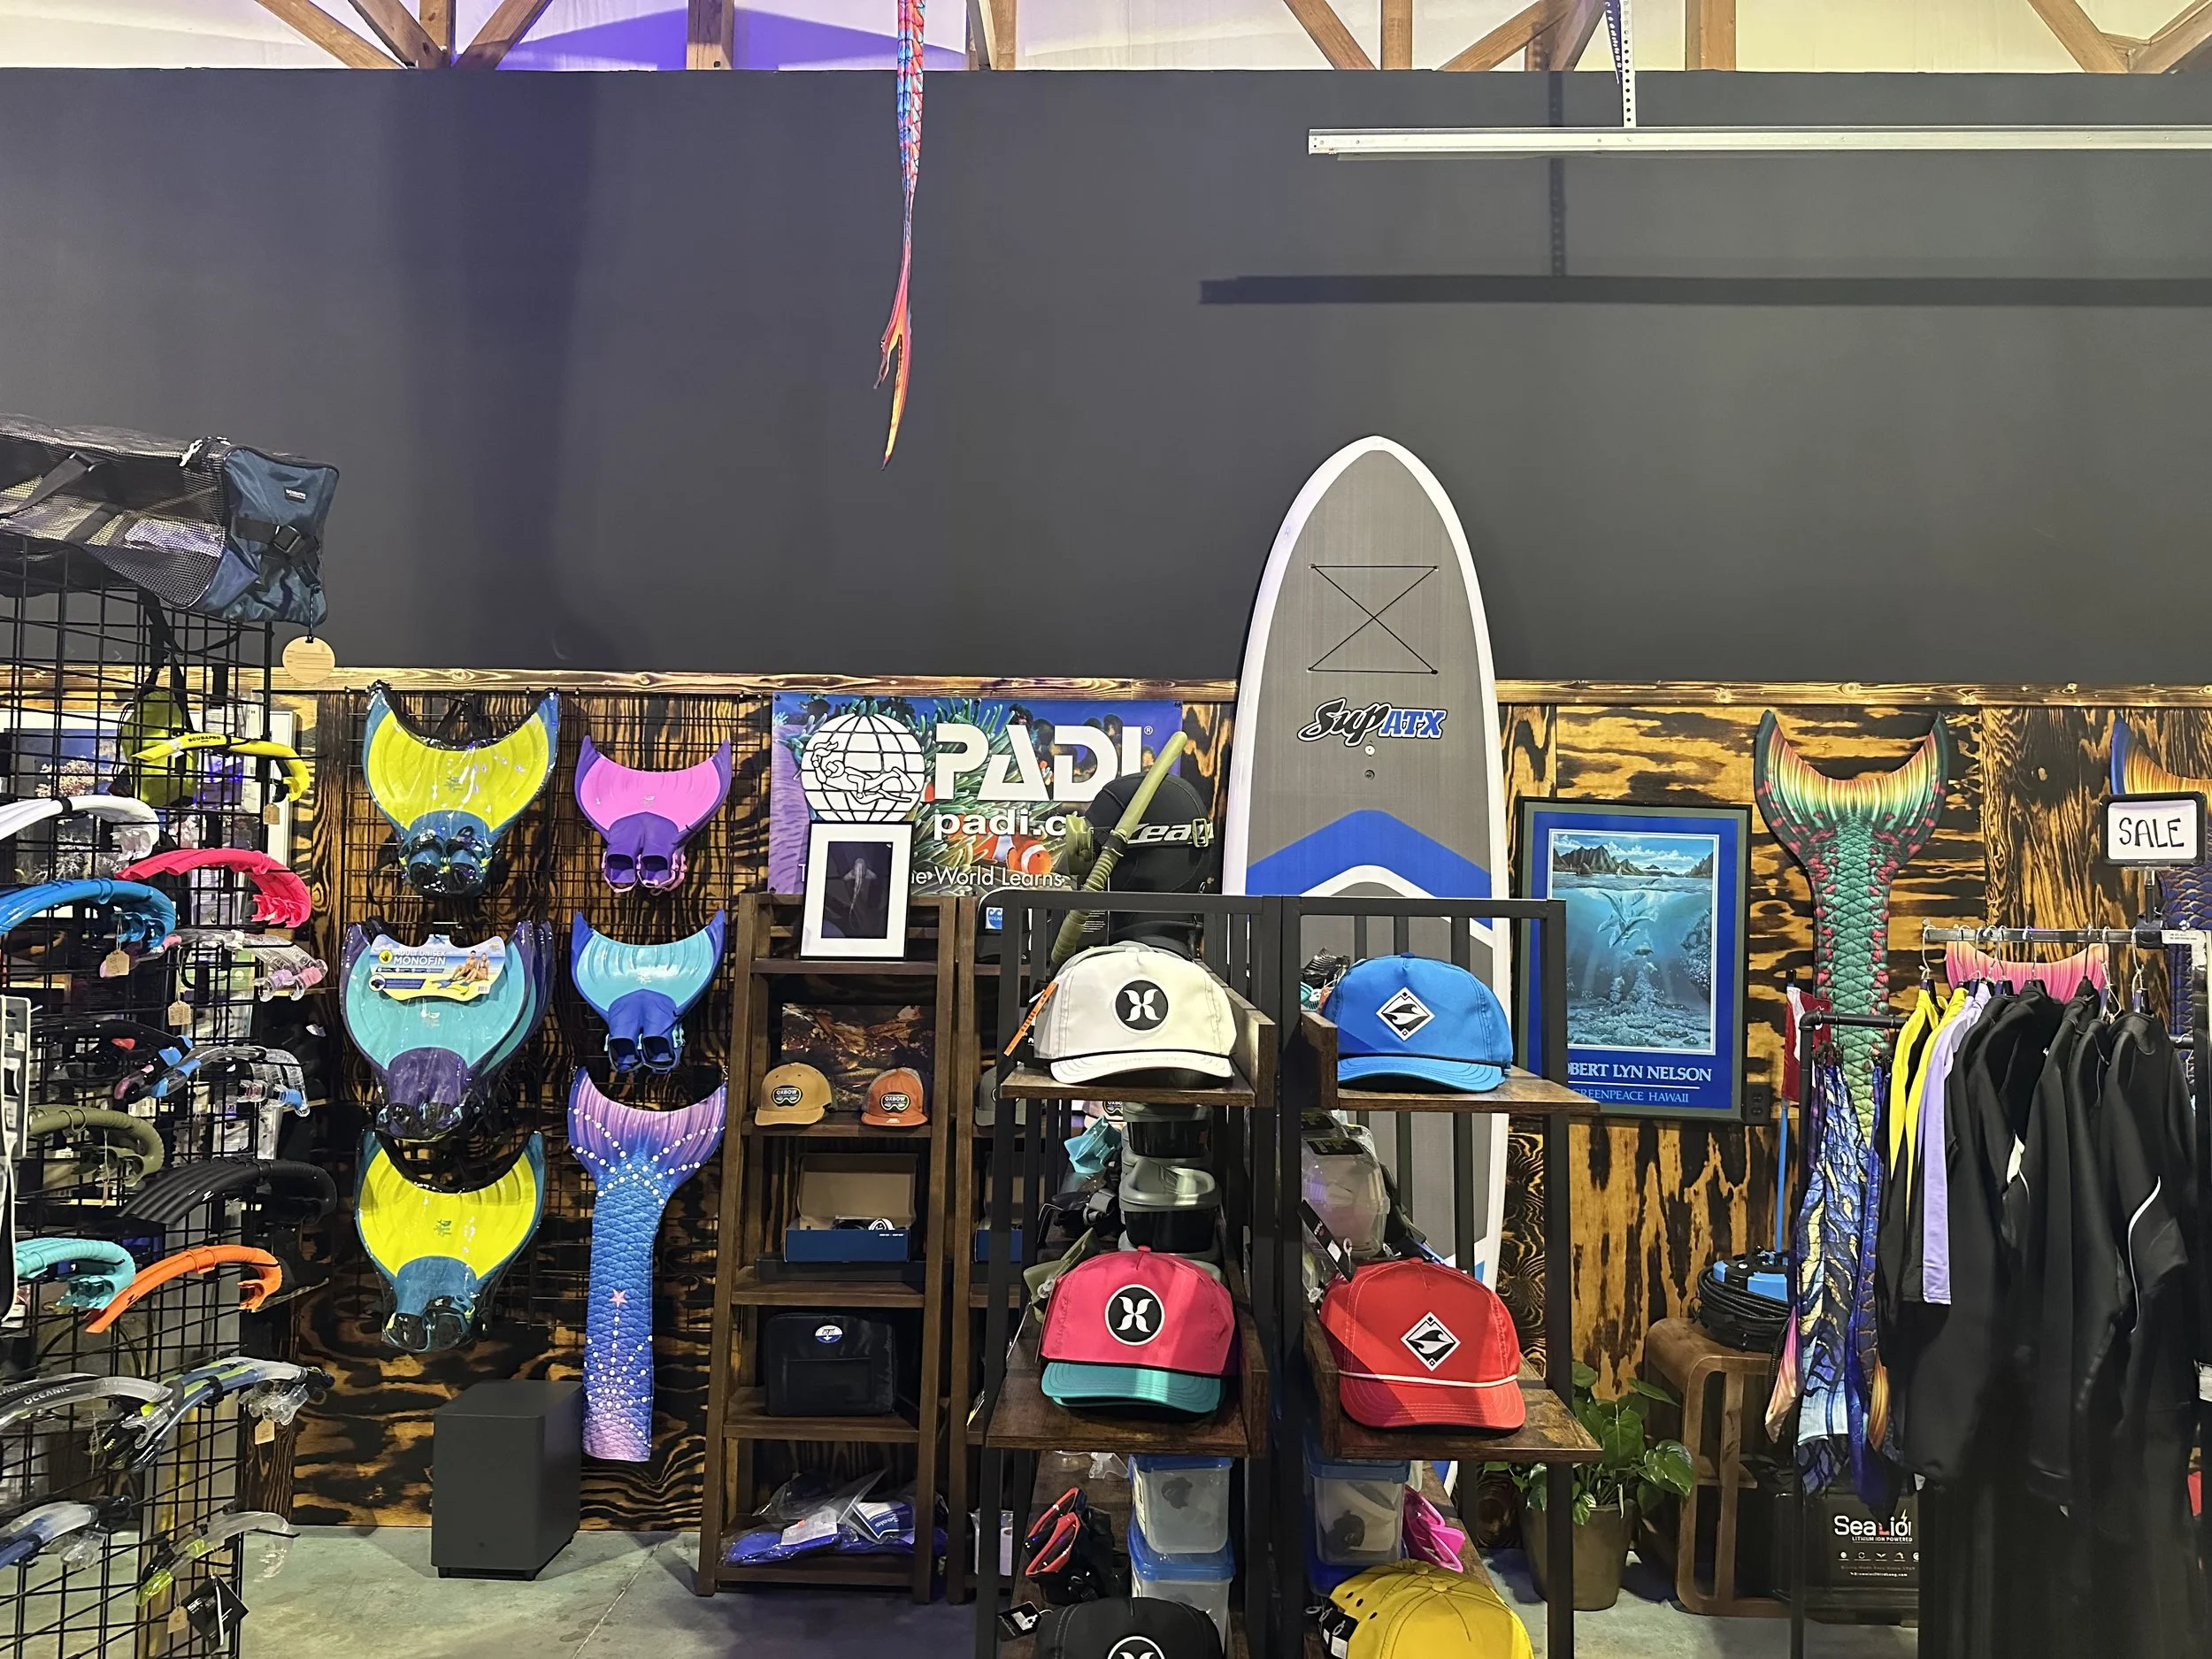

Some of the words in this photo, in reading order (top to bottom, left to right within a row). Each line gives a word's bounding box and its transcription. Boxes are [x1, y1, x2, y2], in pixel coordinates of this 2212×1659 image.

[934, 723, 1142, 802] PADI
[933, 809, 1067, 841] padi.c
[2119, 817, 2185, 848] SALE
[934, 864, 994, 886] World
[1002, 866, 1064, 887] Learns
[394, 956, 446, 965] MONOFIN
[1567, 1062, 1609, 1077] BERT
[1613, 1064, 1643, 1079] LYN
[1647, 1066, 1712, 1082] NELSON
[1573, 1088, 1644, 1101] REENPEACE
[1648, 1092, 1689, 1103] HAWAII
[23, 1386, 71, 1405] OCEANIC
